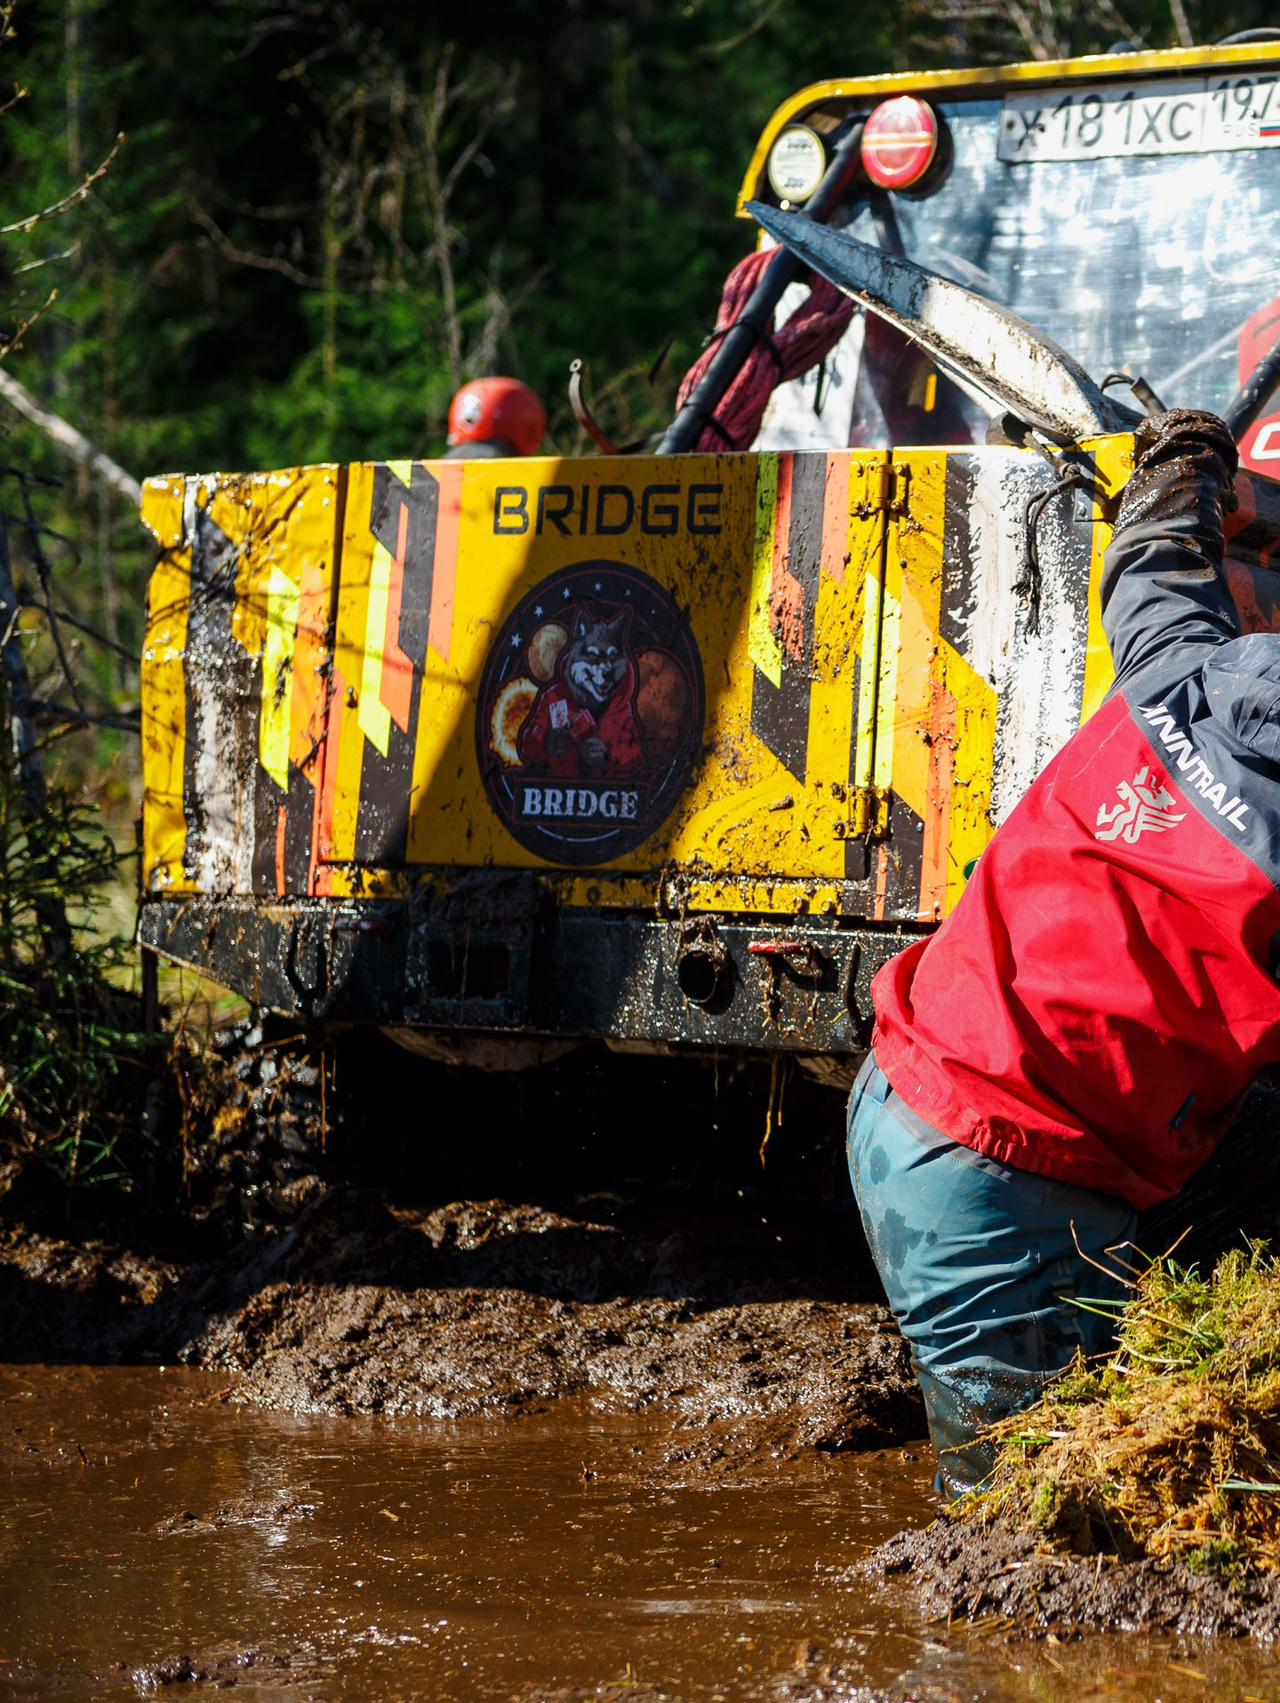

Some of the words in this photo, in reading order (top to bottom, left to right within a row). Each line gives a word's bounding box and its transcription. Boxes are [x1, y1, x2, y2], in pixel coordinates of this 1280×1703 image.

[493, 483, 725, 536] BRIDGE
[1137, 702, 1250, 833] INNTRAIL
[522, 787, 639, 820] BRIDGE
